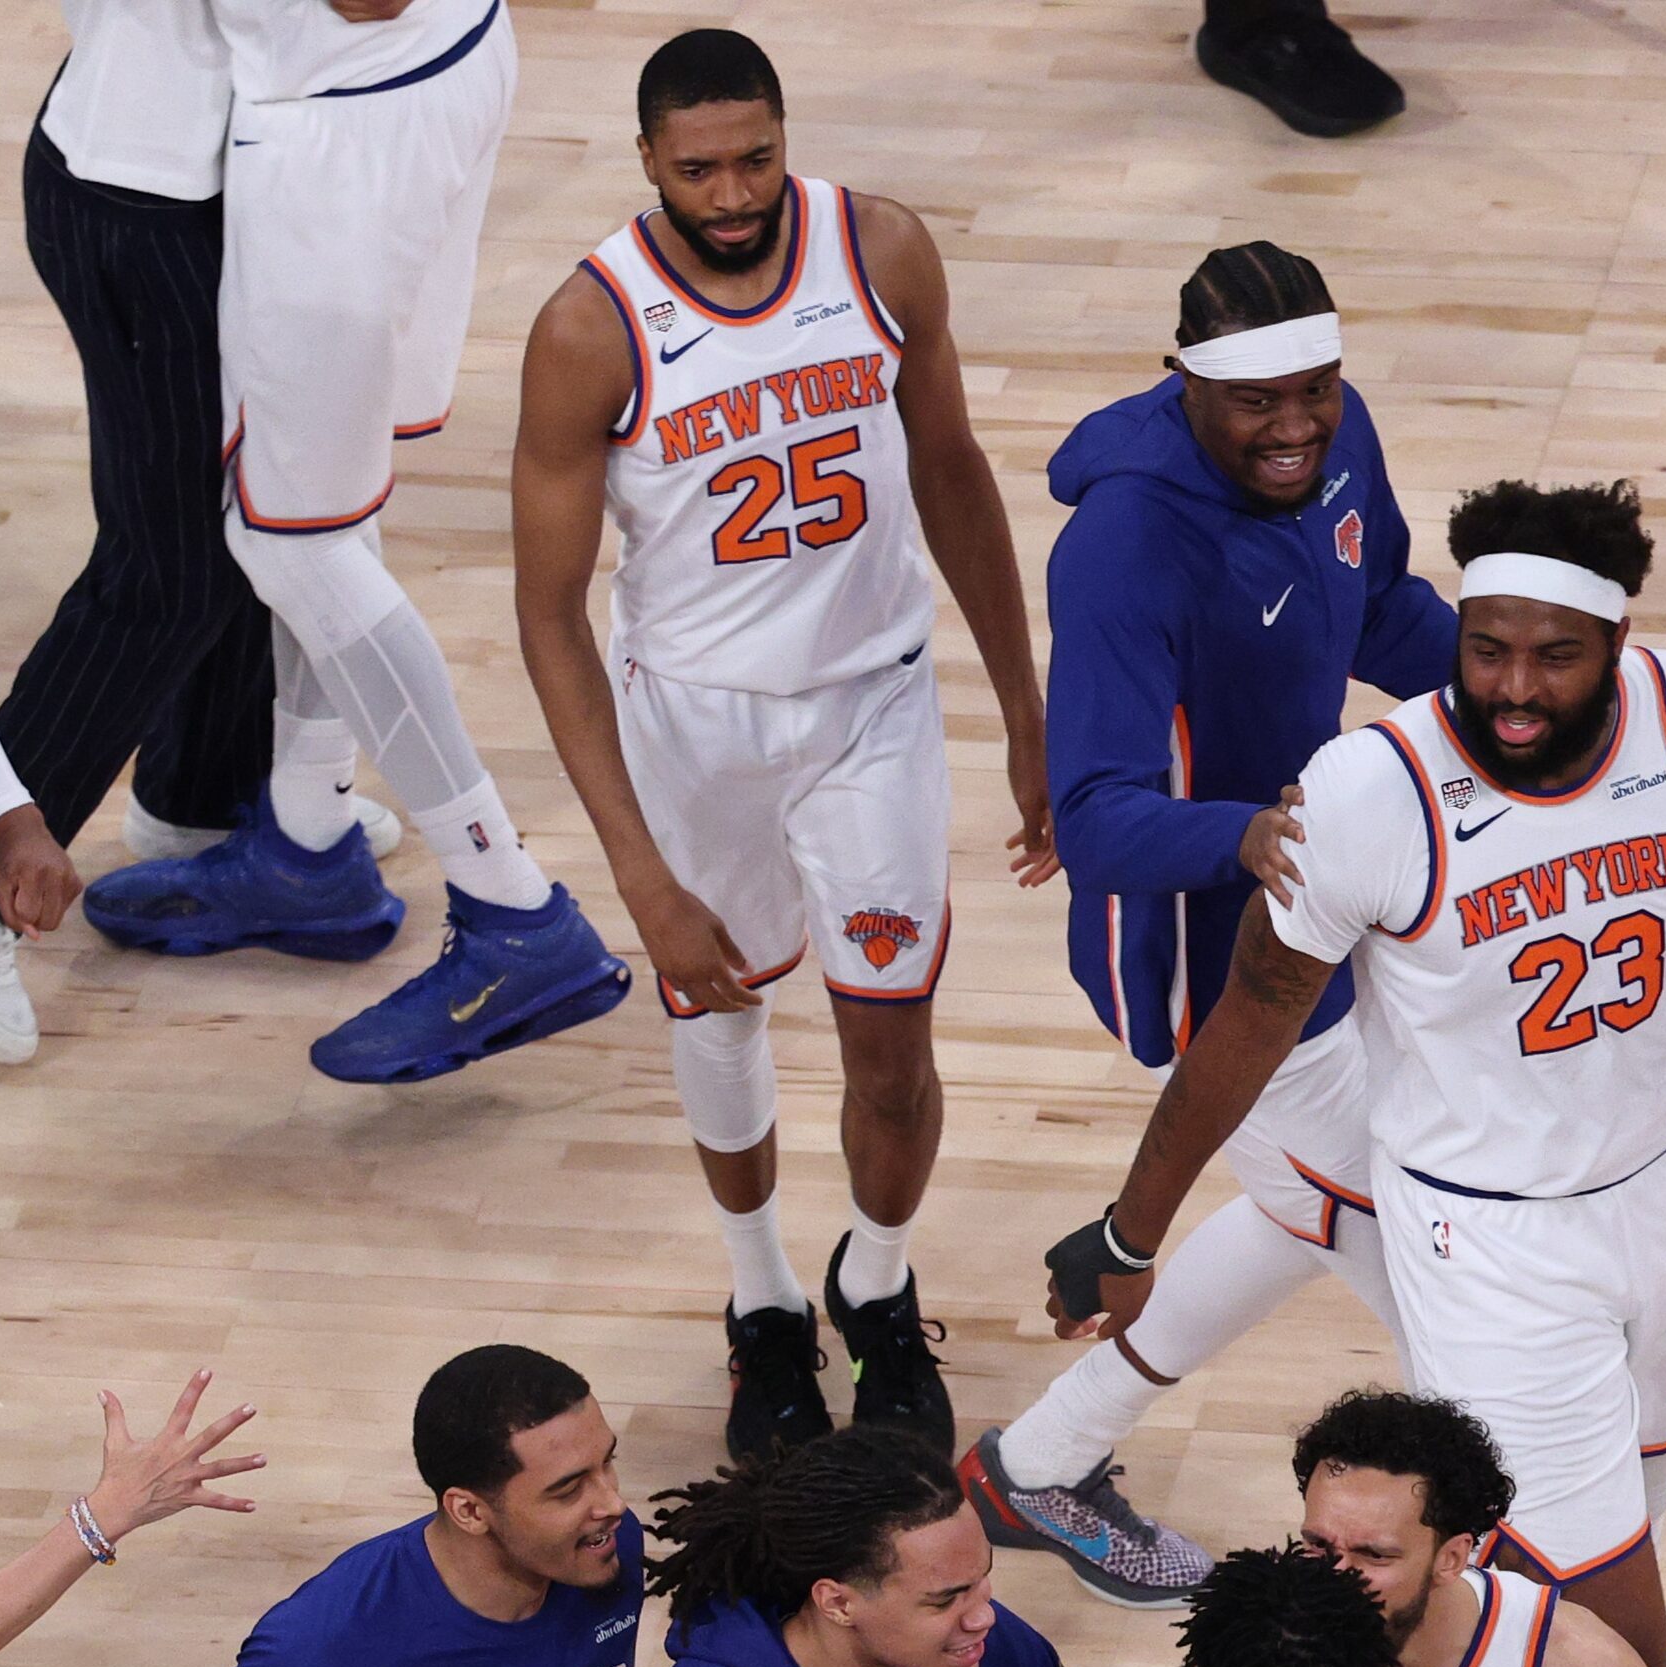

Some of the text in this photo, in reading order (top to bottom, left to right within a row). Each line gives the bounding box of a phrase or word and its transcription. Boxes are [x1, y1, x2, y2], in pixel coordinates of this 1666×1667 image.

[654, 353, 887, 465] NEW YORK
[707, 424, 868, 566] 25
[1443, 780, 1472, 793] USA
[1446, 792, 1476, 807] 250
[1612, 786, 1635, 800] abu
[1455, 856, 1567, 950] NEW
[1508, 908, 1666, 1058] 23
